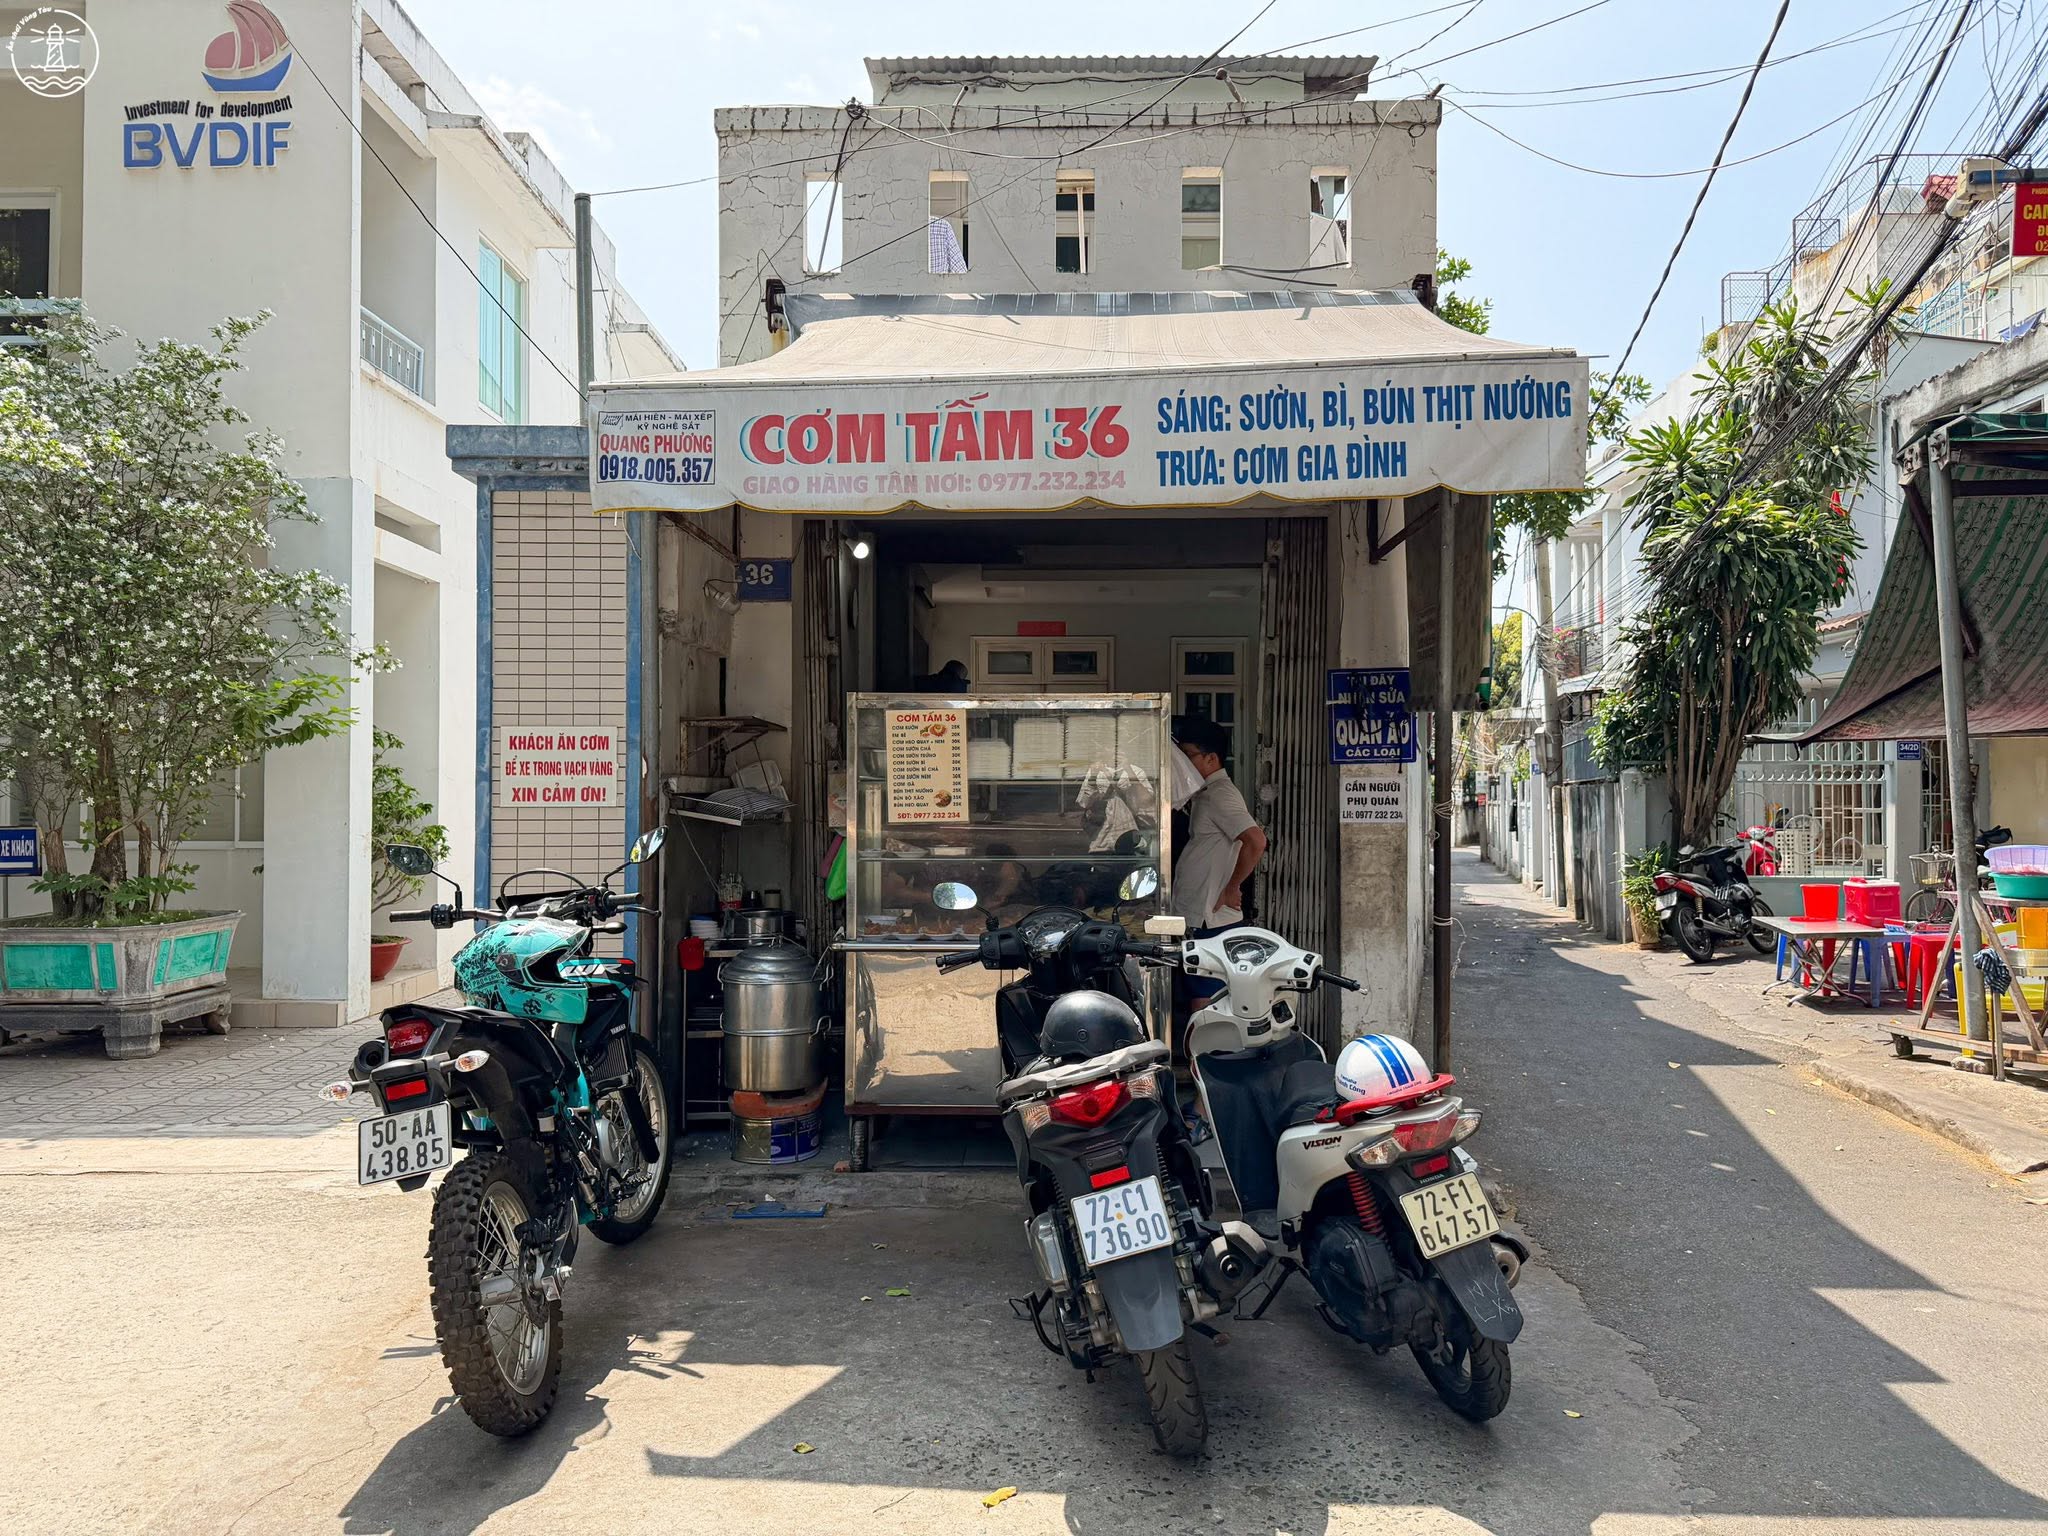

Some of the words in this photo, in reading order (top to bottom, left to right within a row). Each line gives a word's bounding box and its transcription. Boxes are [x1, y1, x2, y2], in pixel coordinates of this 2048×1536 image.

[124, 100, 190, 121] Investment
[195, 101, 214, 118] for
[220, 95, 293, 118] development
[123, 122, 292, 168] BVDIF
[1157, 389, 1231, 434] SÁNG:
[1239, 384, 1315, 432] SƯỜN,
[1322, 382, 1354, 430] BÌ,
[1363, 380, 1415, 425] BÚN
[1422, 384, 1475, 429] THỊT
[1483, 375, 1571, 420] NƯỚNG
[625, 413, 642, 422] MÁI
[644, 413, 666, 421] HIÊN
[674, 413, 692, 421] MÁI
[693, 412, 712, 420] XẾP
[637, 422, 649, 431] KỸ
[652, 422, 678, 431] NGHỆ
[681, 421, 700, 430] SẮT
[747, 408, 885, 465] CƠM
[904, 391, 1033, 463] TẤM
[1053, 405, 1130, 460] 36
[600, 433, 650, 454] QUANG
[654, 431, 712, 454] PHƯƠNG
[599, 454, 713, 483] 0918.005.357
[1156, 445, 1225, 486] TRƯA:
[1233, 443, 1288, 485] CƠM
[1297, 444, 1339, 482] GIA
[1346, 434, 1407, 479] ĐÌNH
[743, 475, 800, 494] GIAO
[806, 472, 868, 494] HÀNG
[875, 471, 918, 496] TẬN
[925, 472, 972, 493] NƠI:
[978, 470, 1126, 492] 0977.232.234
[745, 563, 774, 585] 36
[1370, 673, 1395, 686] ĐÂY
[1378, 687, 1405, 704] SỬA
[896, 713, 920, 723] CƠM
[922, 711, 942, 722] TẤM
[945, 714, 957, 722] 36
[1336, 708, 1382, 746] QUẦN
[509, 732, 553, 751] KHÁCH
[557, 732, 576, 751] ĂN
[580, 734, 610, 751] CƠM
[1345, 746, 1370, 757] CÁC
[1373, 748, 1400, 758] LOẠI
[505, 755, 517, 776] ĐỂ
[519, 761, 531, 776] XE
[533, 761, 562, 776] TRONG
[564, 761, 587, 780] VẠCH
[589, 758, 613, 776] VÀNG
[511, 787, 537, 802] XIN
[542, 782, 576, 802] CẢM
[580, 785, 607, 802] ƠN!
[1369, 780, 1401, 792] NGƯỜI
[1347, 797, 1368, 807] PHỤ
[1370, 795, 1399, 807] QUÁN
[1342, 810, 1354, 819] LH:
[1355, 810, 1373, 819] 0977
[1374, 810, 1388, 819] 232
[1389, 810, 1403, 819] 234
[0, 839, 10, 857] XE
[11, 834, 35, 857] KHÁCH
[1349, 1084, 1366, 1096] Công
[372, 1110, 436, 1148] 50-AA
[1302, 1135, 1342, 1150] VISION
[366, 1137, 444, 1180] 438.85
[1085, 1184, 1149, 1227] 72-C1
[1413, 1179, 1473, 1220] 72-F1
[1085, 1213, 1167, 1260] 736.90
[1419, 1204, 1490, 1251] 647.57
